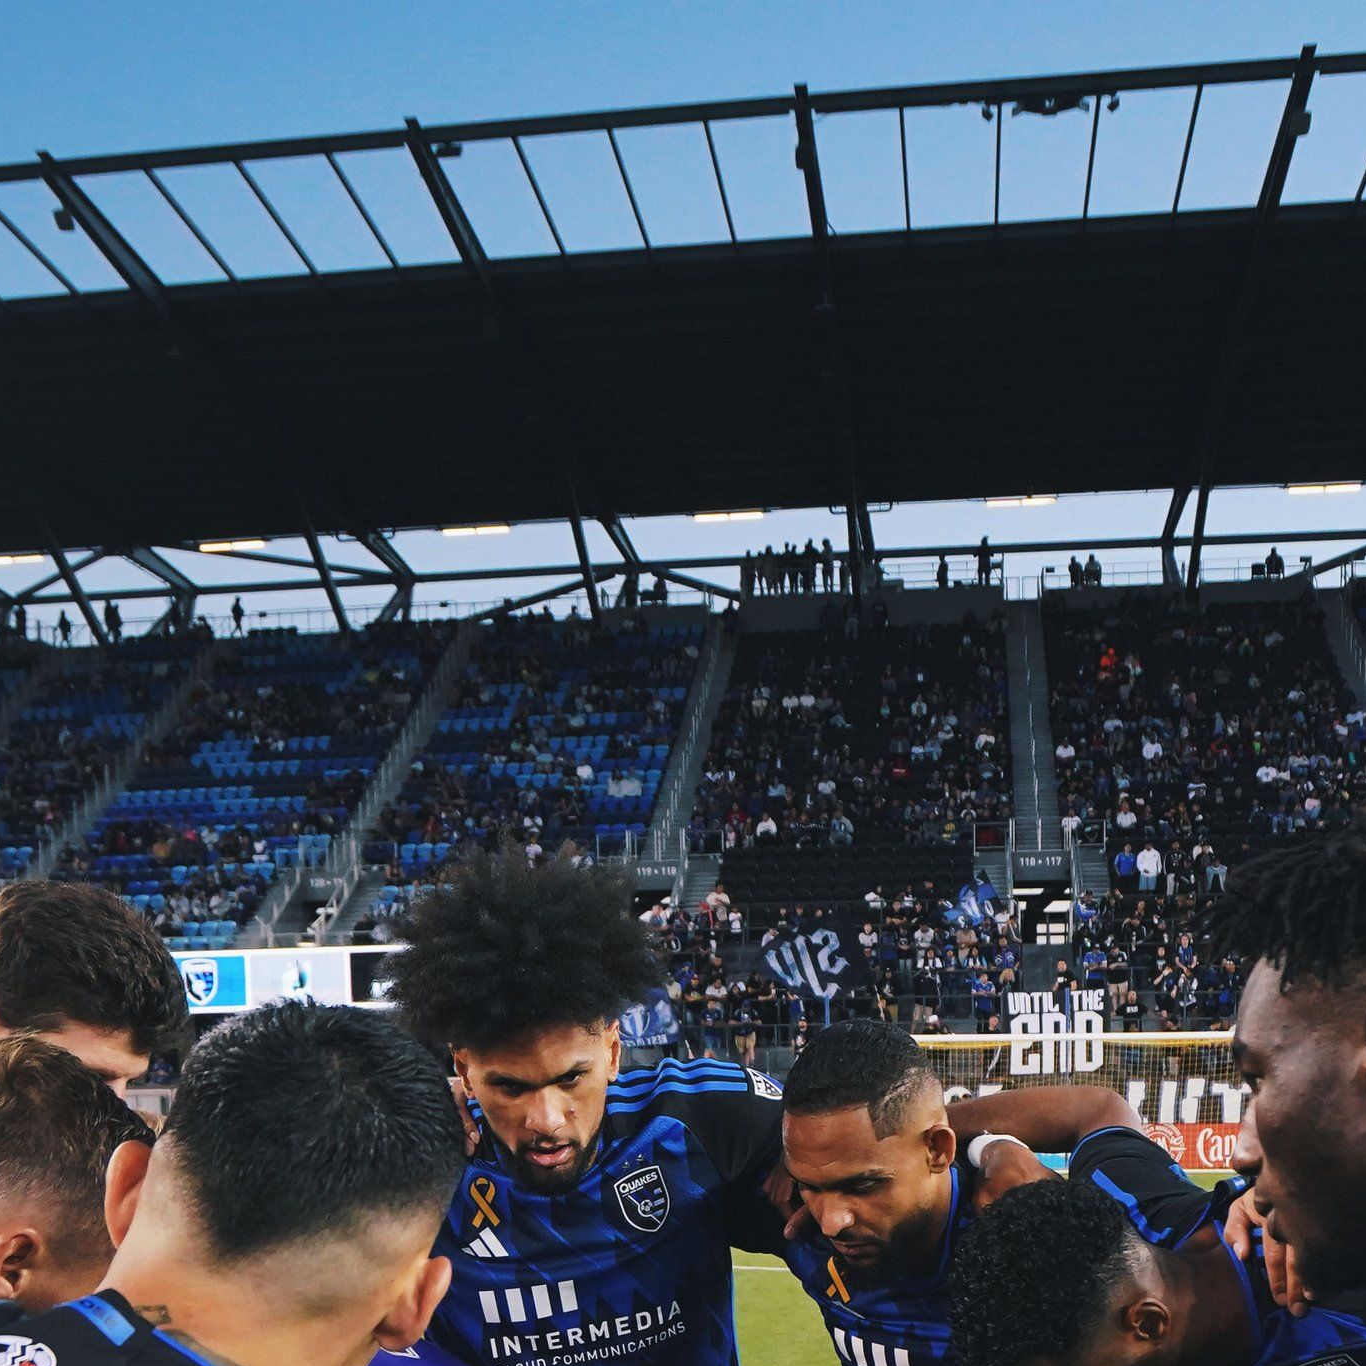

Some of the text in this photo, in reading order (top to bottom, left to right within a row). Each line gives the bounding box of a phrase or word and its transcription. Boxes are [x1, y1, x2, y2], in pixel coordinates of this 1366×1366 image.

[1008, 989, 1105, 1015] UNTIL THE
[1010, 1010, 1104, 1075] END
[619, 1172, 658, 1194] QUAKES
[489, 1300, 682, 1358] INTERMEDIA
[552, 1321, 686, 1366] COMMUNICATIONS
